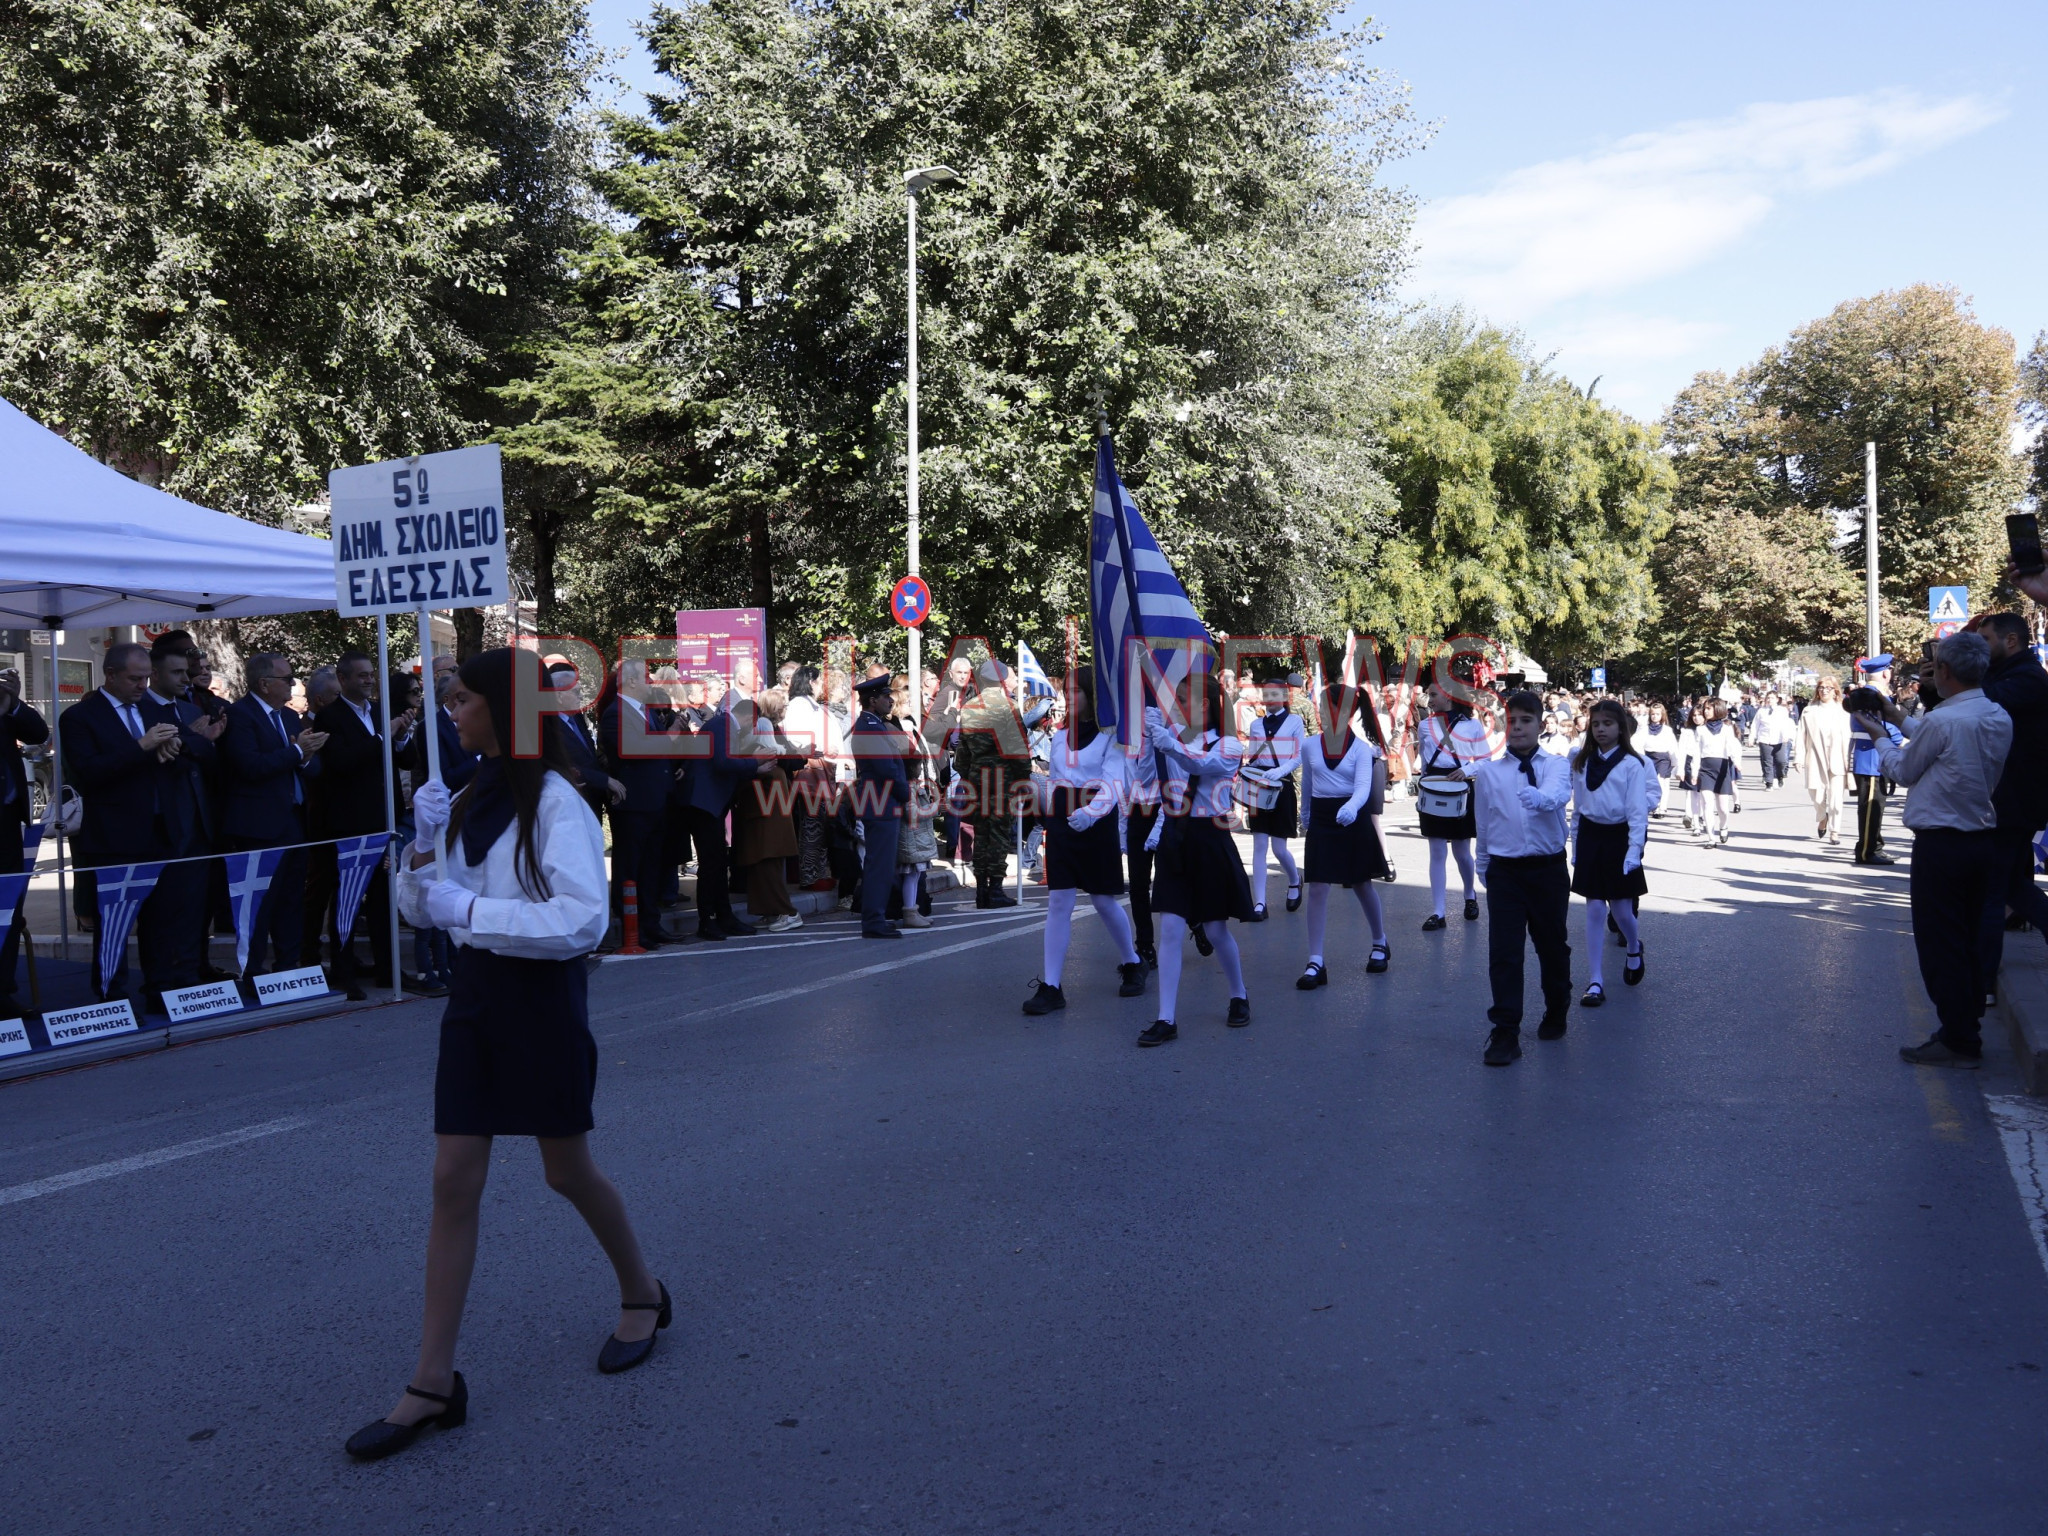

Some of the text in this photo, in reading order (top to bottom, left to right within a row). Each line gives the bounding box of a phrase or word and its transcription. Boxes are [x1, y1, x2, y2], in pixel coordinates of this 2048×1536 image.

[340, 506, 498, 562] ΔΗΜ. ΣΧΟΛΕΙΟ
[348, 556, 492, 607] ΕΔΕΣΣΑΣ
[178, 986, 225, 1003] ΠΡΟΕΔΡΟΣ
[258, 975, 325, 995] ΒΟΥΛΕΥΤΕΣ
[48, 1004, 128, 1026] ΕΚΠΡΟΣΩΠΟΣ
[171, 996, 239, 1016] Τ. ΚΟΙΝΟΤΗΤΑΣ
[53, 1017, 132, 1040] ΚΥΒΕΡΝΗΣΗΣ
